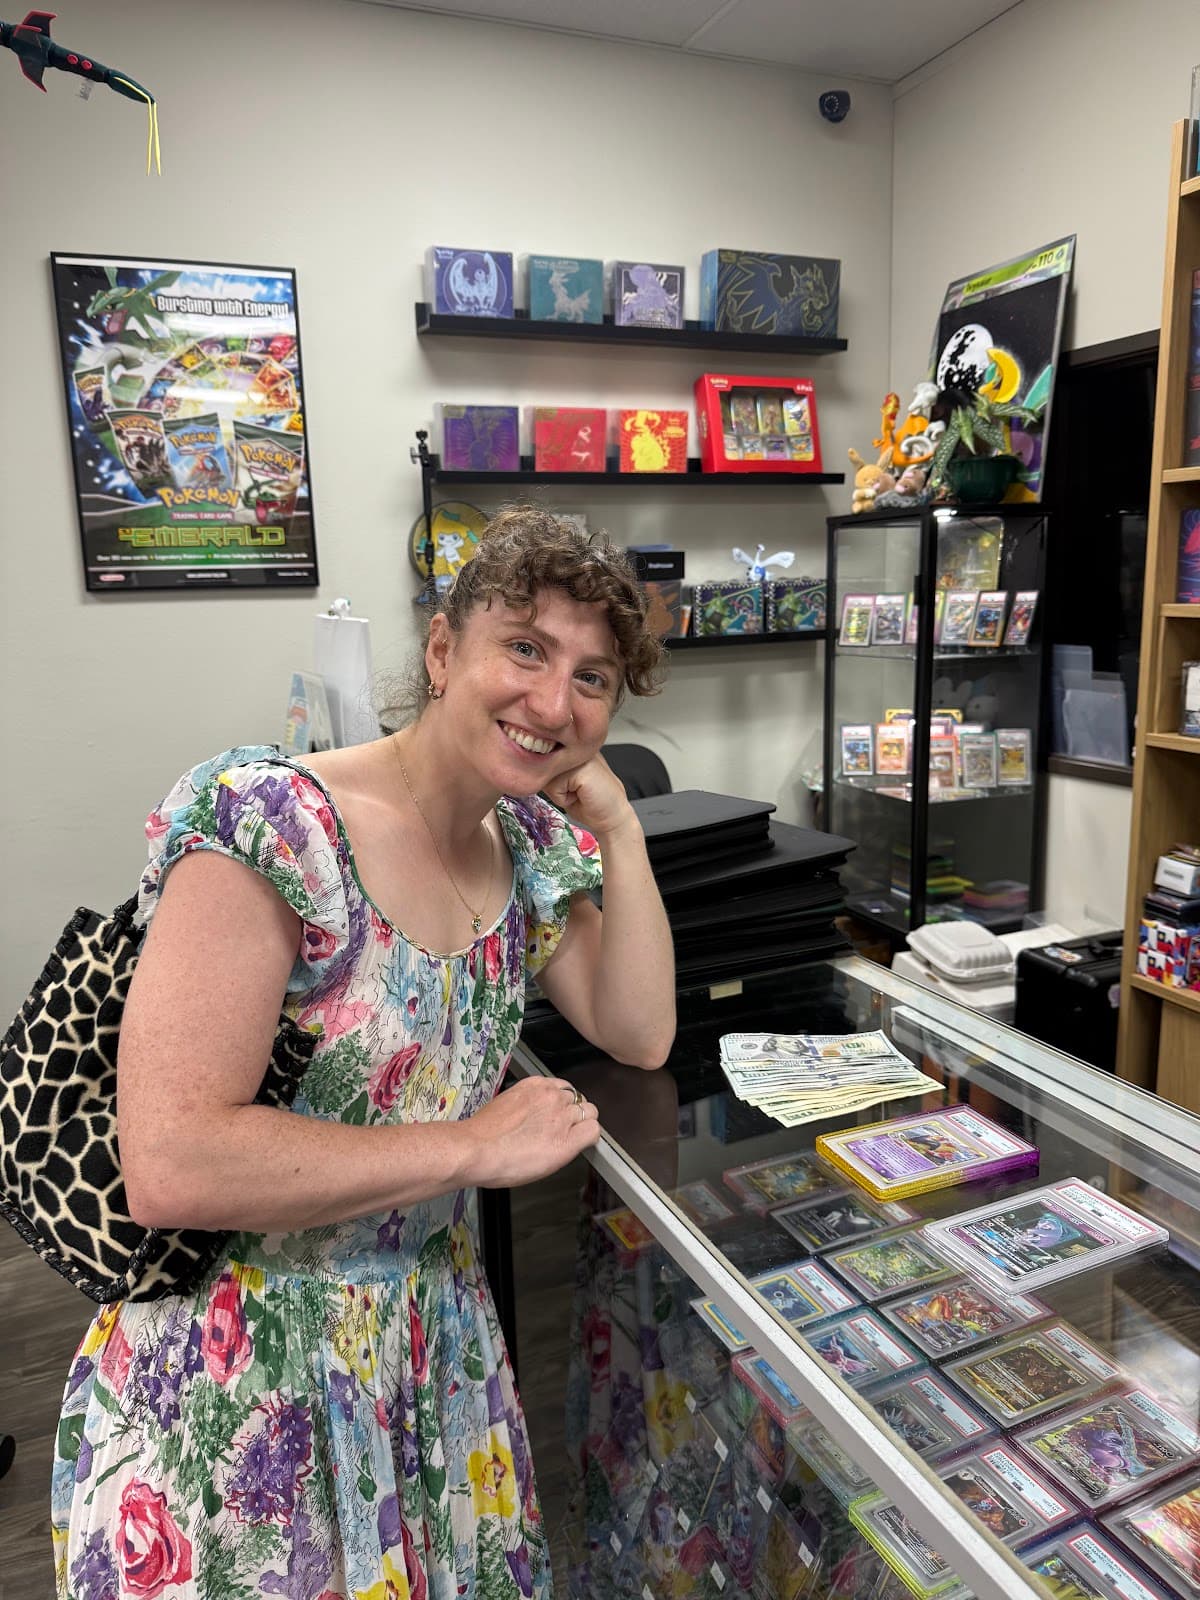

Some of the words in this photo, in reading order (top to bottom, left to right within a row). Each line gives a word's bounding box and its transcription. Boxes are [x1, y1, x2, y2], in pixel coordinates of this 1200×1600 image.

[156, 295, 213, 316] Bursting
[213, 299, 244, 316] with
[245, 301, 289, 320] Energy!
[131, 525, 286, 548] EMERALD
